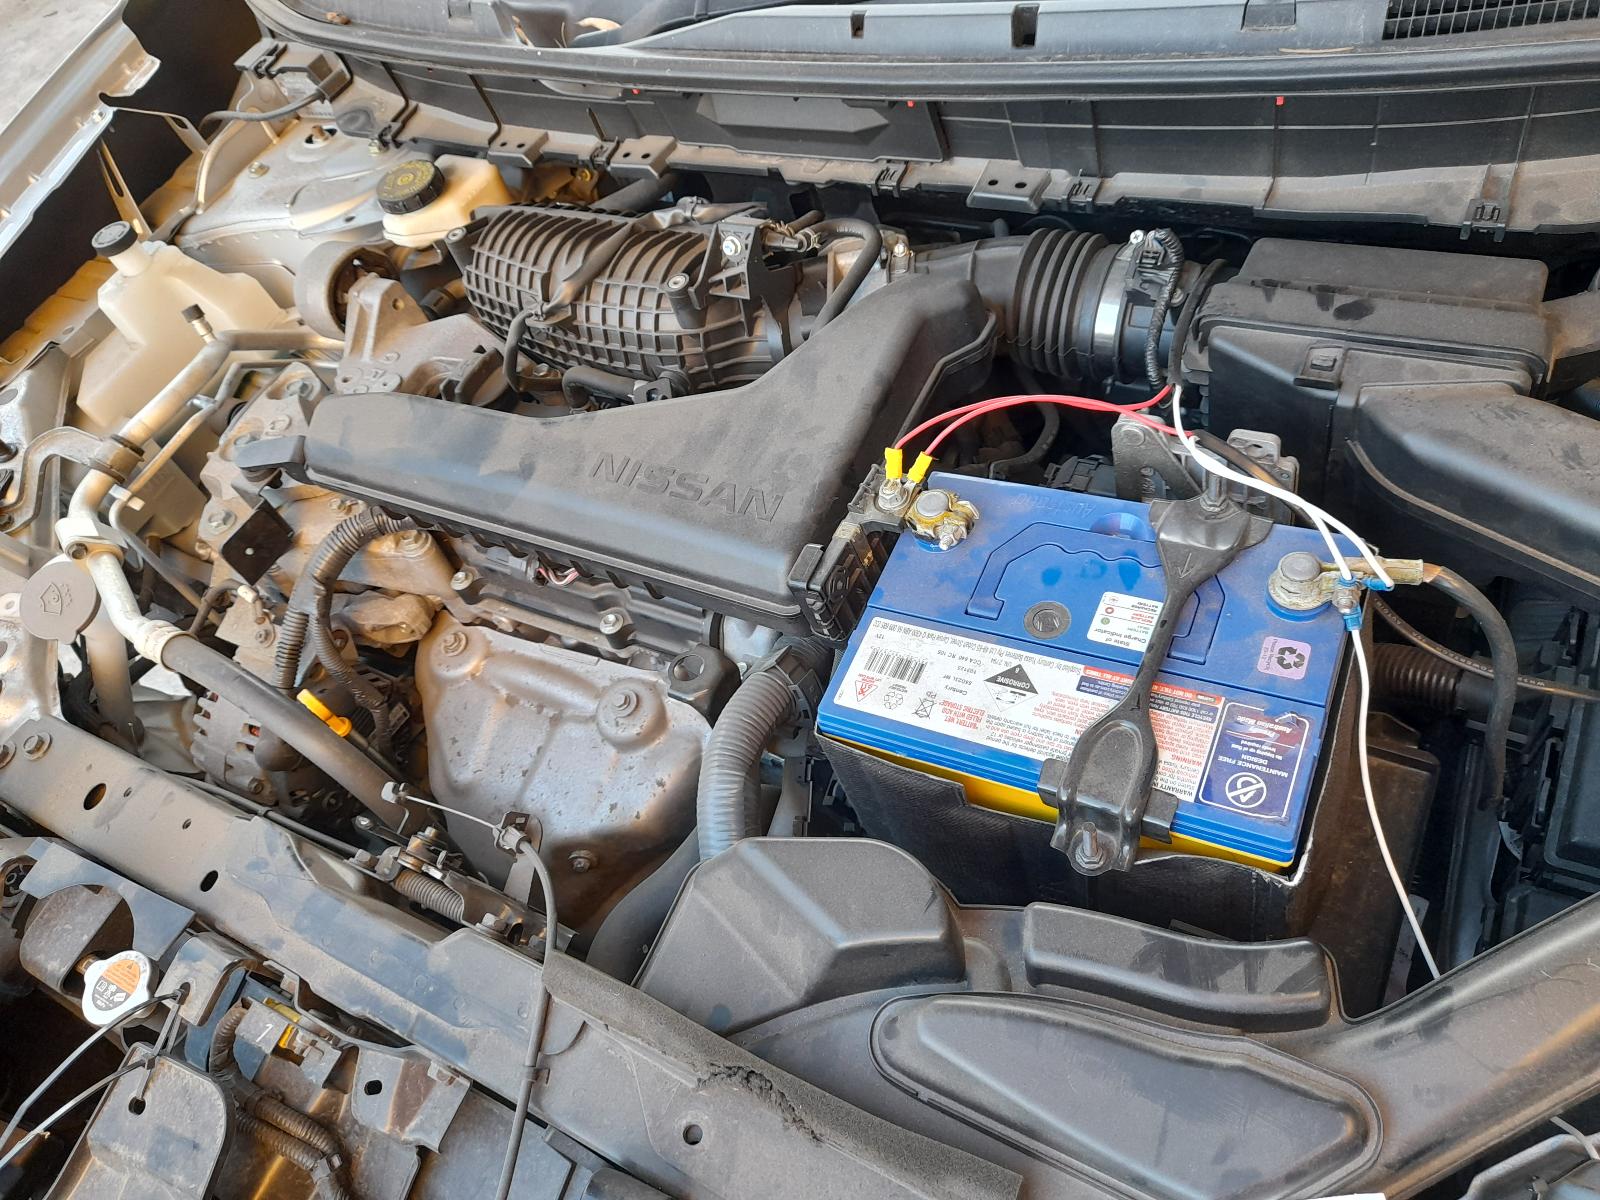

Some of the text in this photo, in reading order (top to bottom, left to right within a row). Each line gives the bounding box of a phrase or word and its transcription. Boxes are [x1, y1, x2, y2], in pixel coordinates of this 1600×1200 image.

[588, 453, 784, 522] NISSAN
[1093, 626, 1147, 643] Charge Indicator
[1112, 638, 1130, 646] State
[946, 651, 957, 659] RC
[967, 656, 982, 665] CCA
[1003, 650, 1024, 662] Batteries
[1035, 657, 1055, 669] Century
[1060, 663, 1082, 676] Supplied
[994, 674, 1031, 689] CORROSIVE
[942, 684, 968, 696] Century
[952, 709, 966, 718] WITH
[961, 704, 985, 716] ELECTRIC
[965, 713, 982, 723] FILLED
[1235, 714, 1292, 734] Australian Made
[1169, 753, 1202, 767] WARNING
[1240, 752, 1268, 765] DESIGN
[1216, 754, 1289, 778] MAINTENANCE FREE
[1159, 783, 1193, 797] WARRANTY
